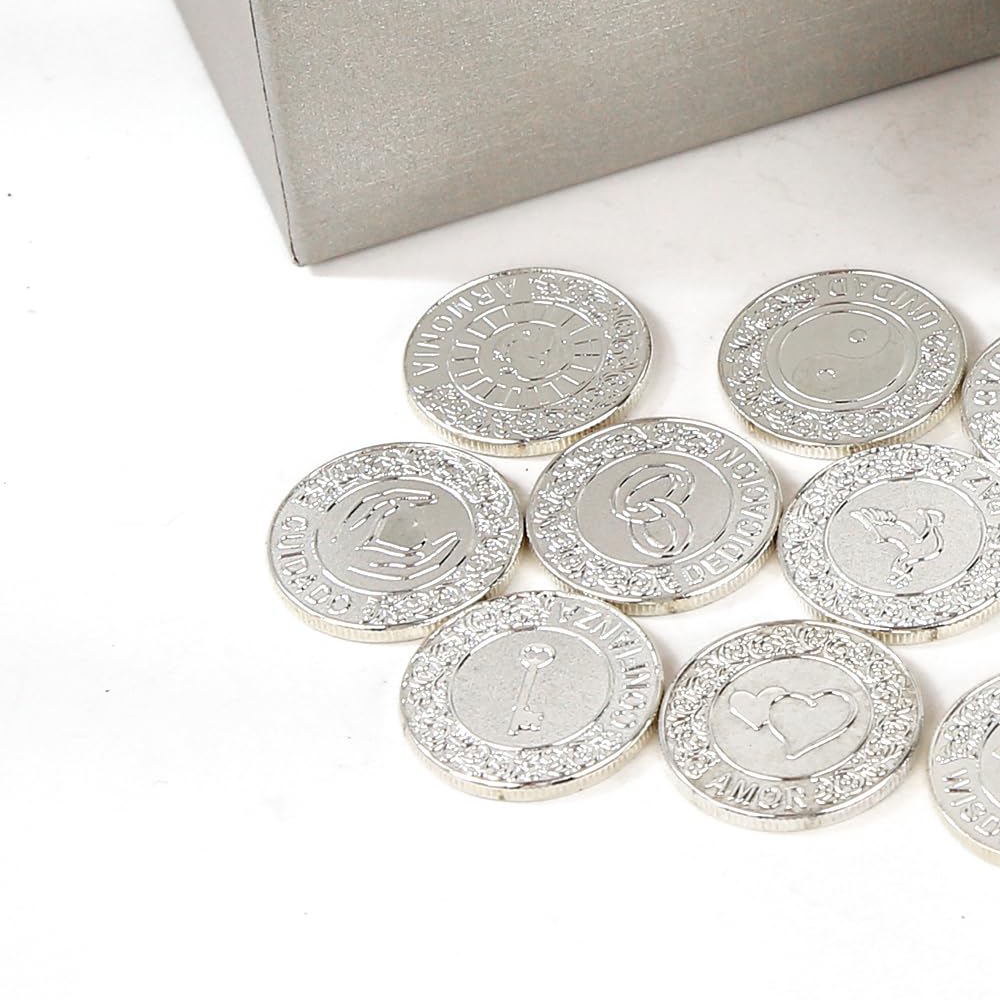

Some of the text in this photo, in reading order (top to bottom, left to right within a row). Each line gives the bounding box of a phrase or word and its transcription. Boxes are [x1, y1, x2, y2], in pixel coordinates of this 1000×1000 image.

[412, 277, 517, 377] ARMONIA
[828, 277, 942, 329] UNIDAD
[277, 515, 351, 616] CUIDADO
[681, 448, 770, 586] DEDICACION
[558, 600, 652, 729] CONFIANZA
[703, 771, 808, 810] AMOR
